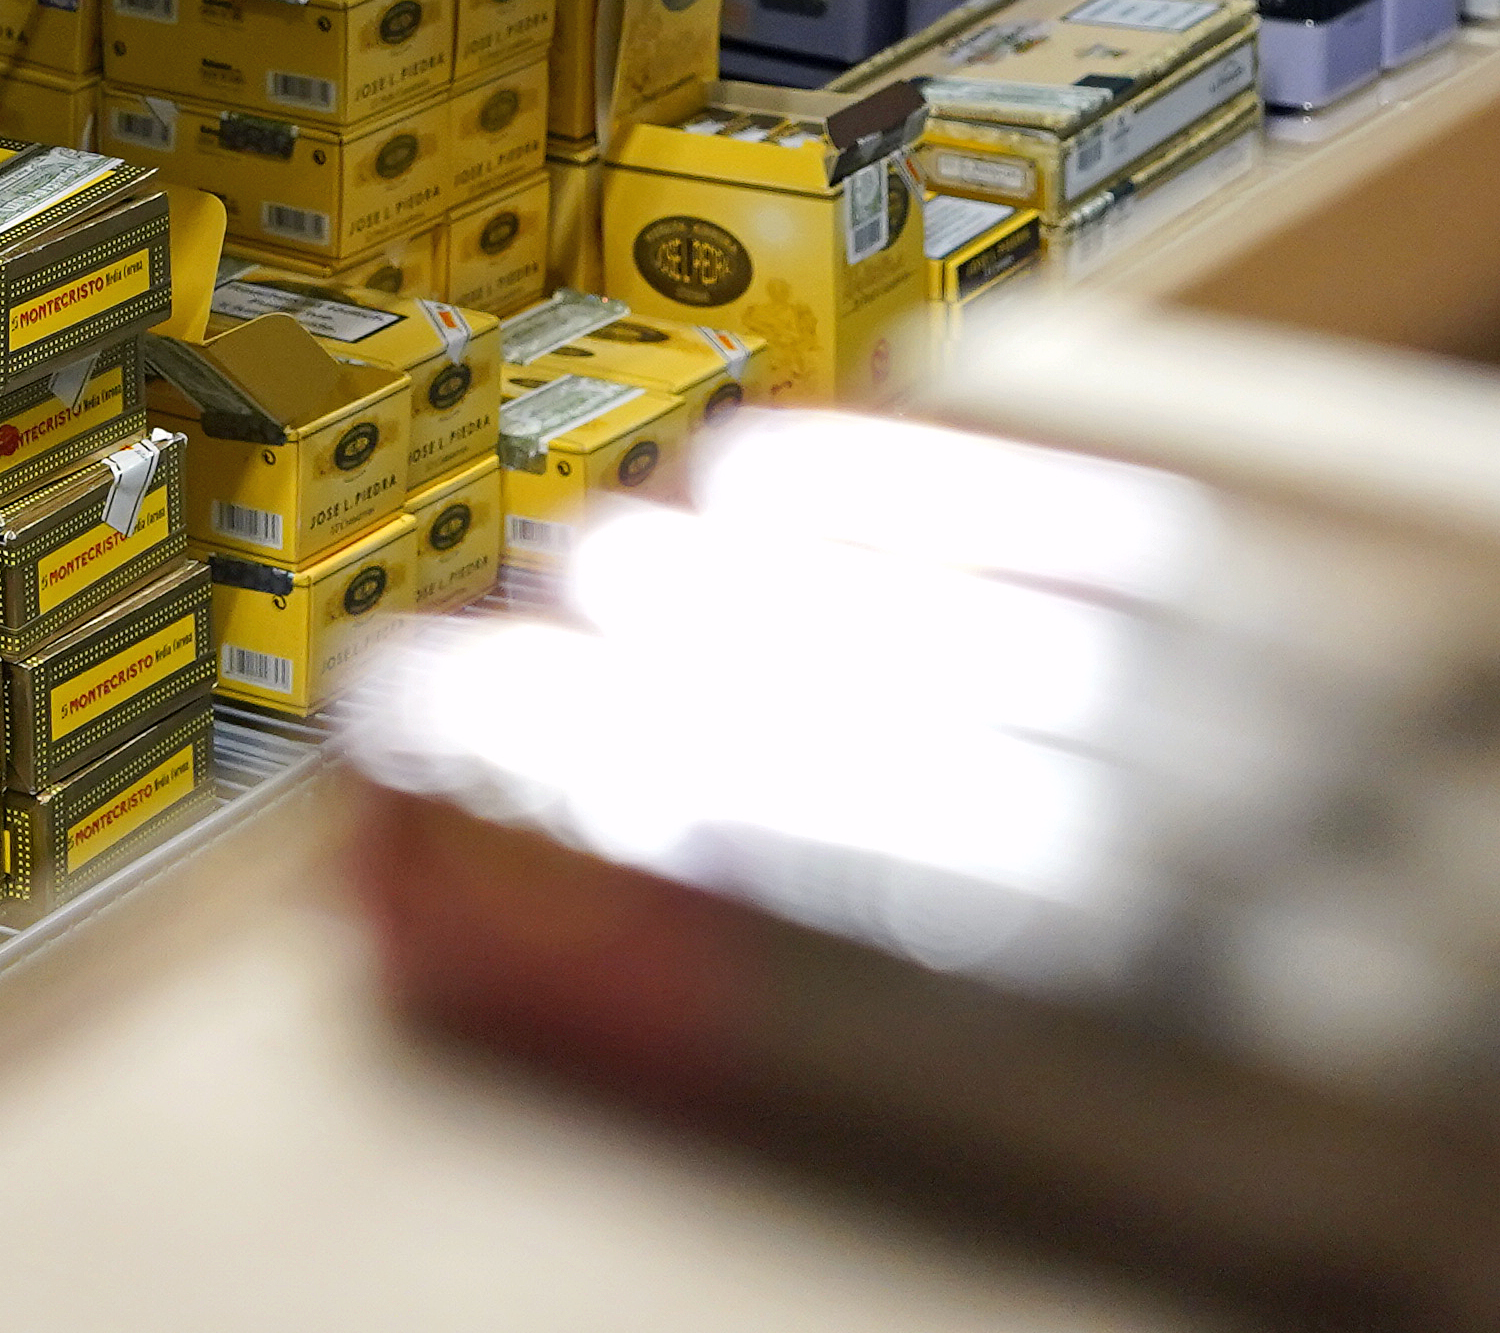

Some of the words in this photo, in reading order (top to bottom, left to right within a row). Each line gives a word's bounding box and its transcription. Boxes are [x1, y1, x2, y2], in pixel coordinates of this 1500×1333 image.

[19, 276, 104, 329] MONTECRISTO
[105, 268, 123, 286] Media
[124, 261, 143, 279] Corona
[68, 655, 154, 716] MONTECRISTO
[75, 783, 153, 848] MONTECRISTO
